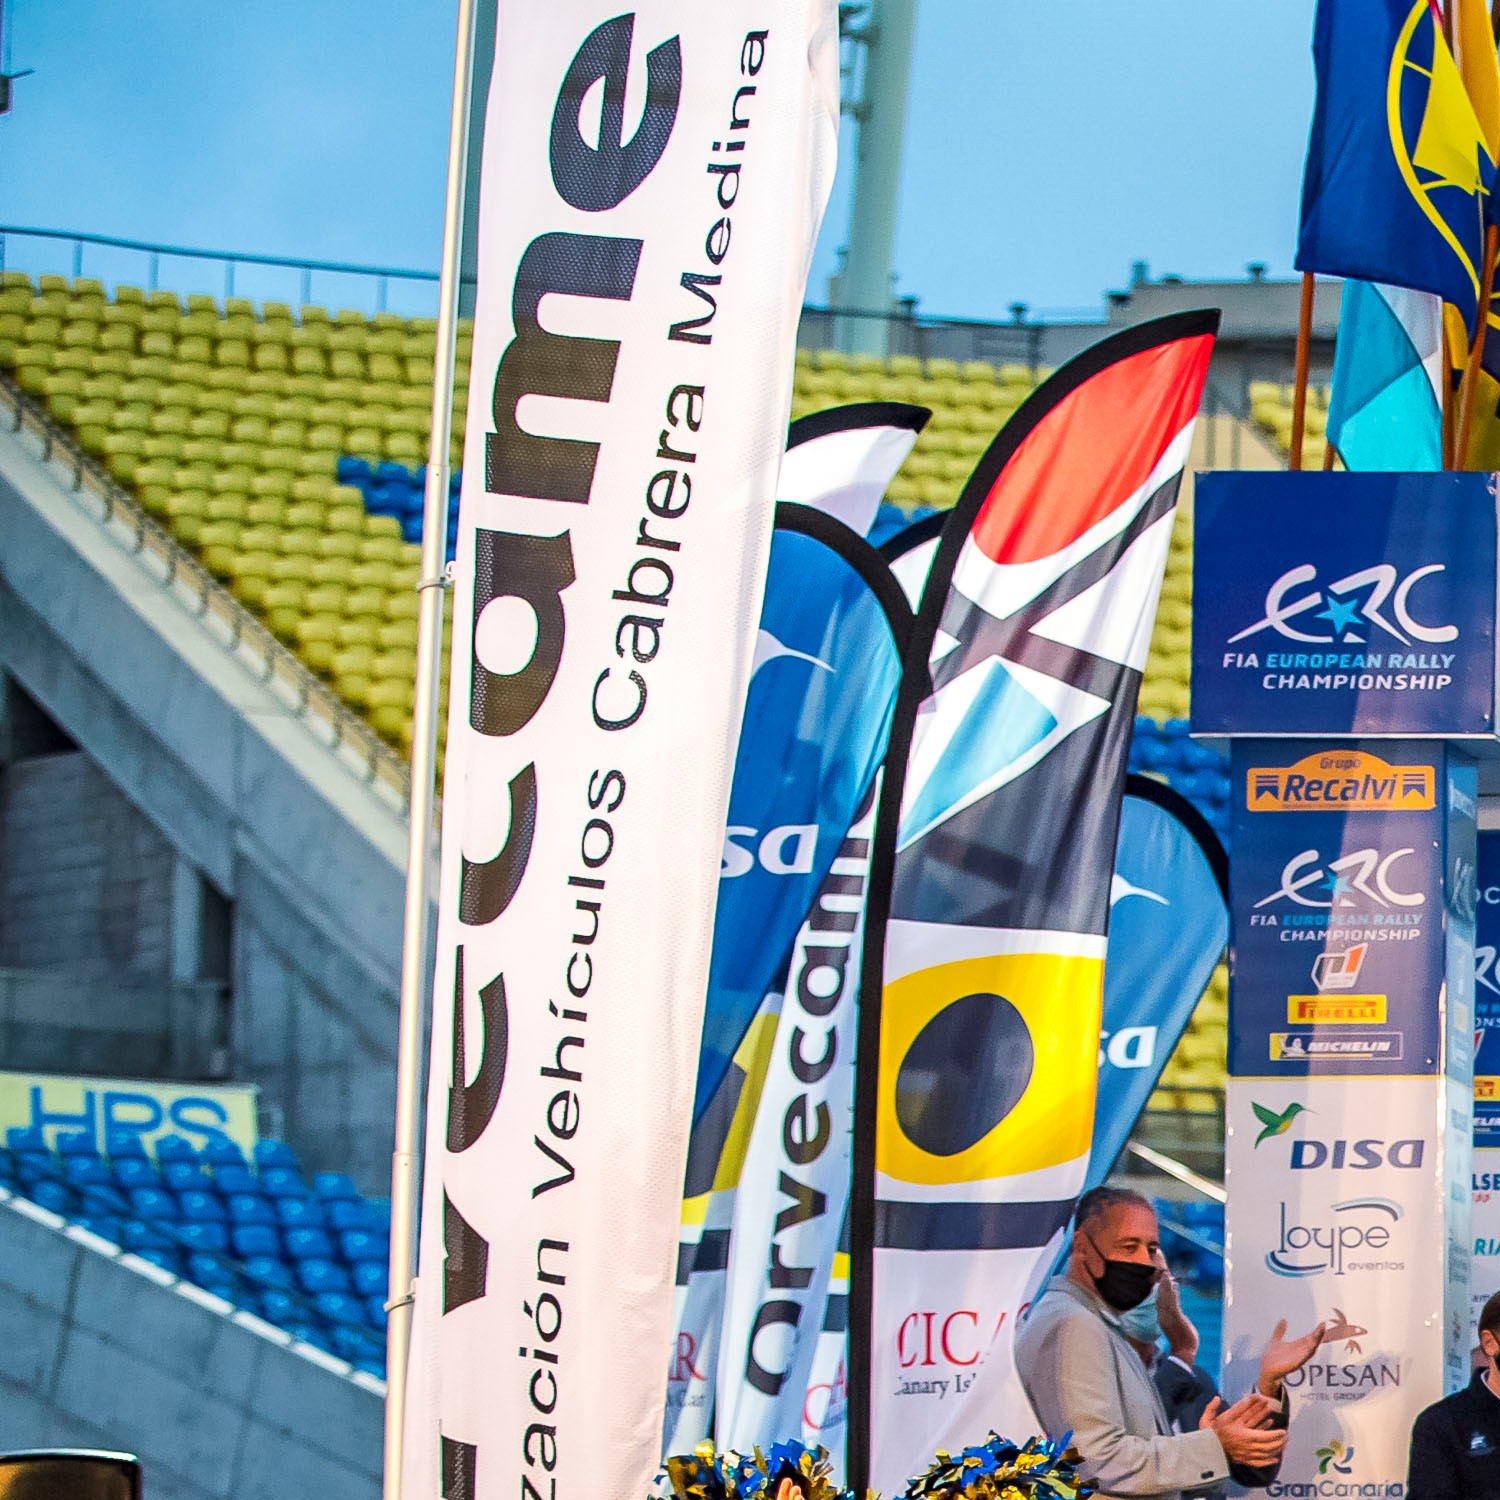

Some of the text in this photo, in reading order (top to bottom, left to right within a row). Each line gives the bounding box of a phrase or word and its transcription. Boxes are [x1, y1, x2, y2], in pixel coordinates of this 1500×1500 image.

[1227, 562, 1460, 648] ERC
[532, 767, 628, 1202] Vehículos
[592, 382, 708, 732] Cabrera
[667, 28, 770, 347] Medina
[1223, 652, 1456, 671] FIA EUROPEAN RALLY
[1262, 674, 1452, 691] CHAMPIONSHIP
[1320, 756, 1361, 770] Grupo
[1283, 773, 1400, 803] Recalvi
[1298, 1001, 1377, 1019] PIRELLI
[1289, 1139, 1425, 1170] DISA
[1347, 1260, 1405, 1272] eventos
